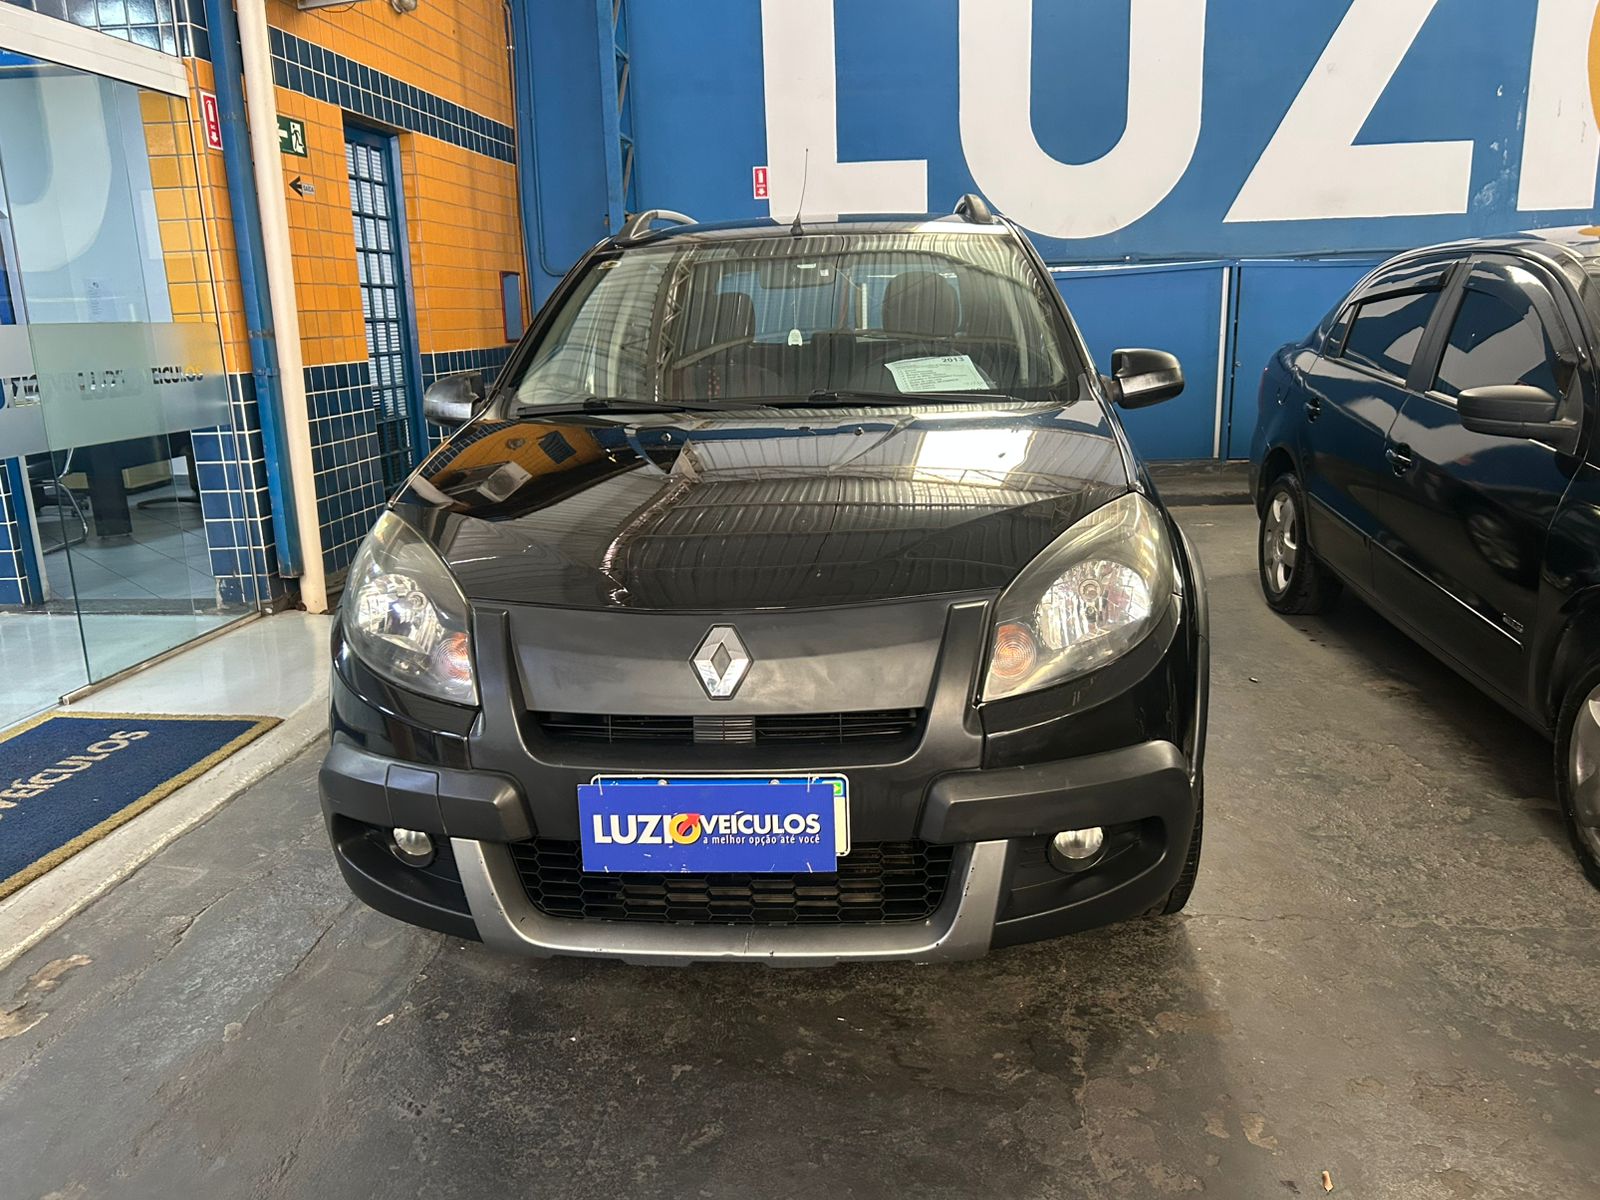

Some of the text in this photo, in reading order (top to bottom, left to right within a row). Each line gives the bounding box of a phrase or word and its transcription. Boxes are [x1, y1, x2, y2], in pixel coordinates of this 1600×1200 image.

[763, 0, 1600, 240] LUZI
[700, 810, 821, 835] VEÍCULOS
[703, 833, 821, 847] a melhor opção até você
